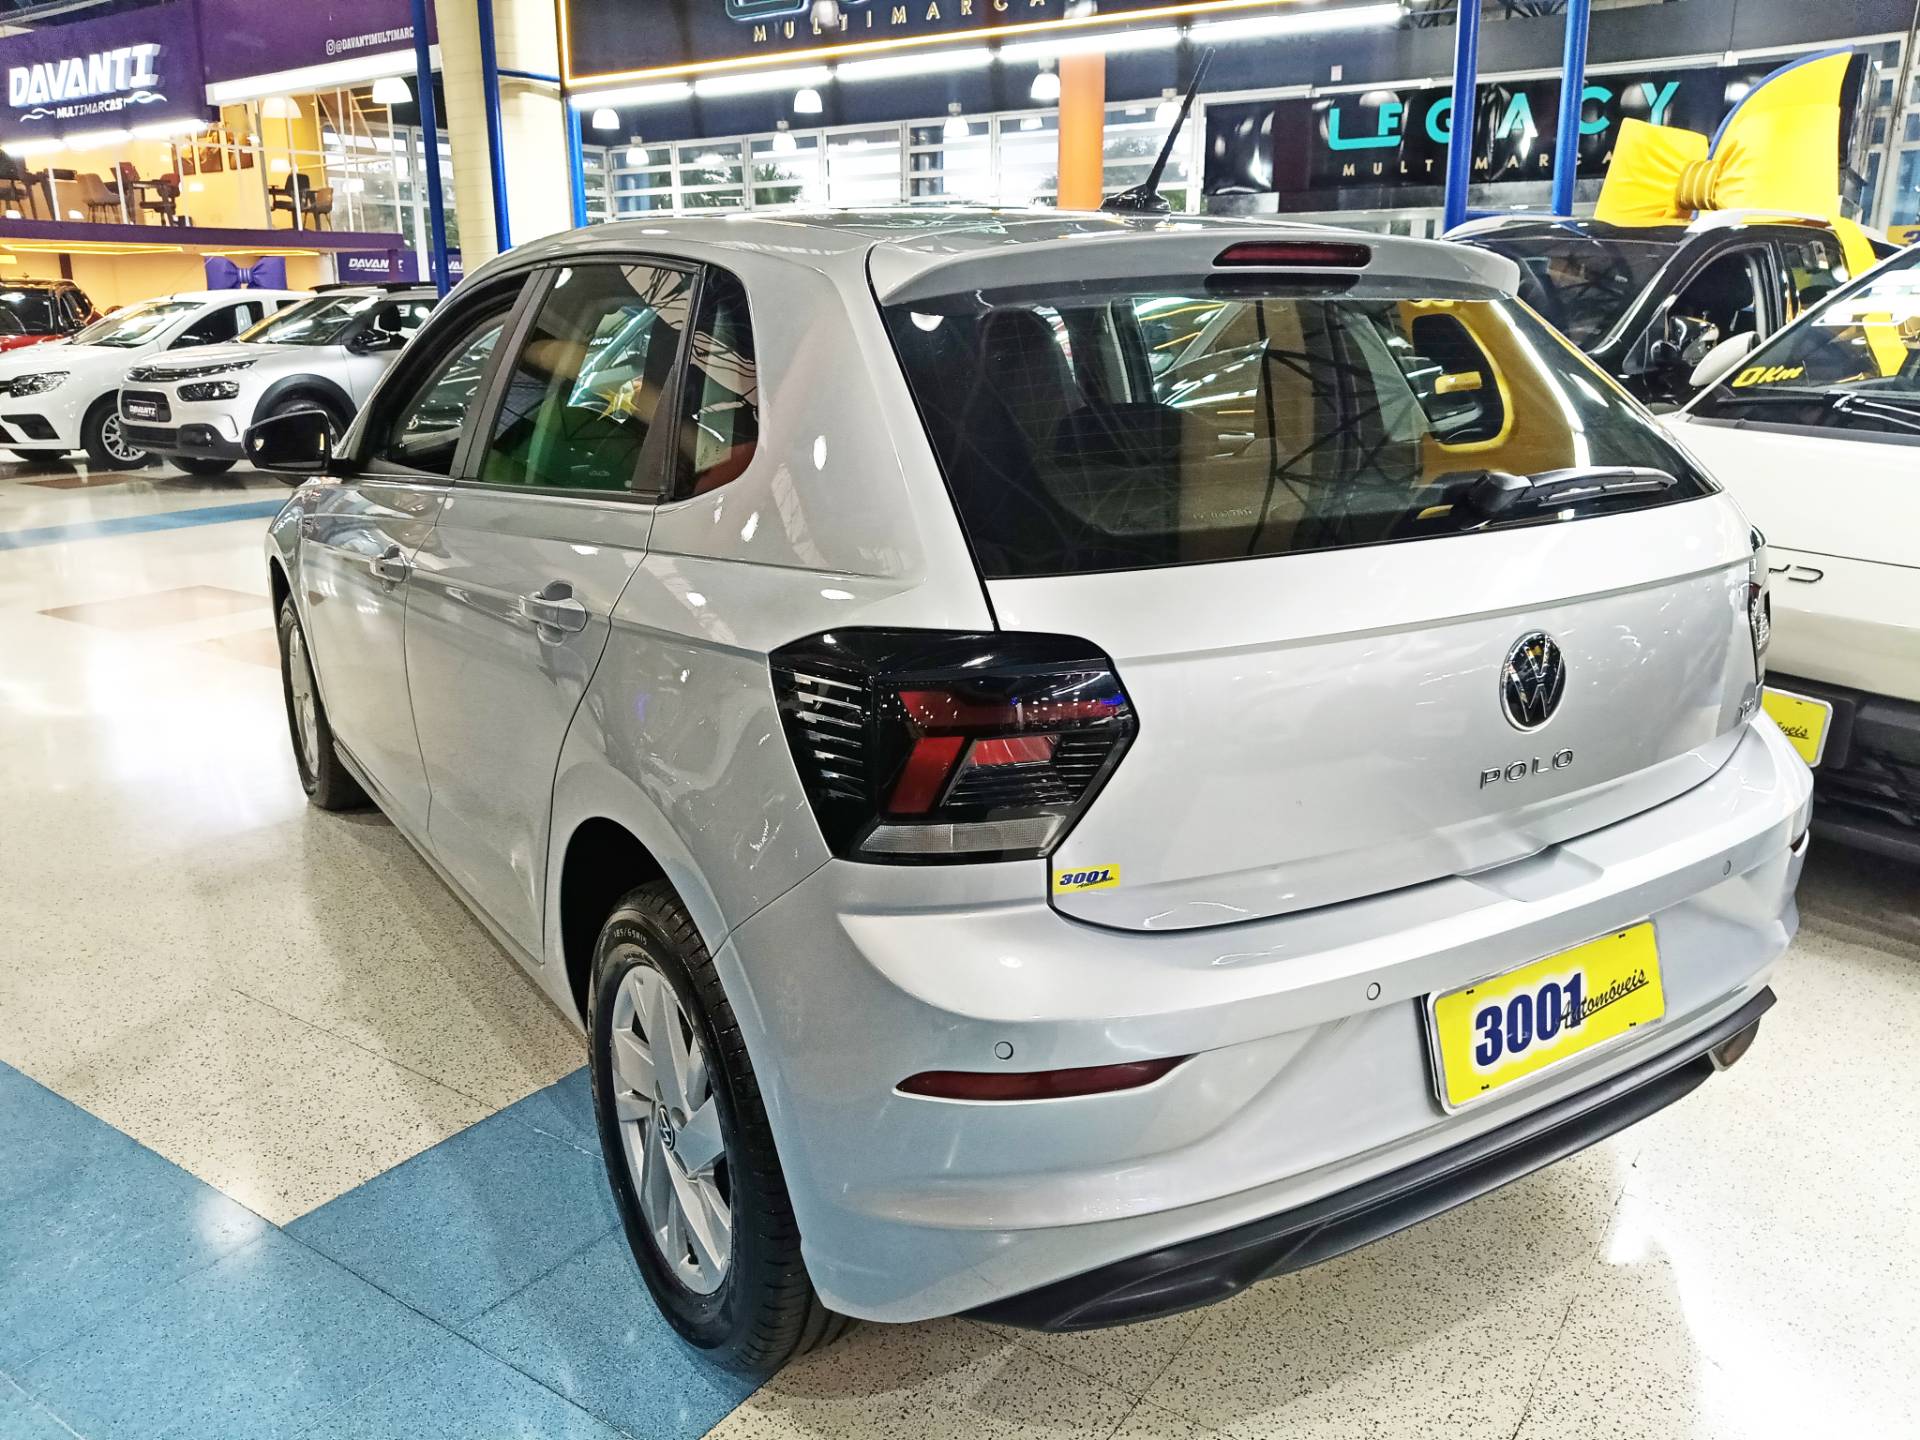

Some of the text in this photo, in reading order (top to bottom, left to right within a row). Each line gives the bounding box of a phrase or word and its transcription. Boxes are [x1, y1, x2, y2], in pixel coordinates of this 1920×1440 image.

[335, 26, 415, 53] @DAVANTIMULTIMARC
[9, 43, 161, 108] DAVANTI
[56, 97, 123, 119] MULTIMARCAS
[1328, 81, 1680, 150] LEGACY
[1480, 748, 1573, 790] POLO
[1060, 870, 1109, 885] 3001
[1475, 968, 1648, 1066] 3001 Automóveis
